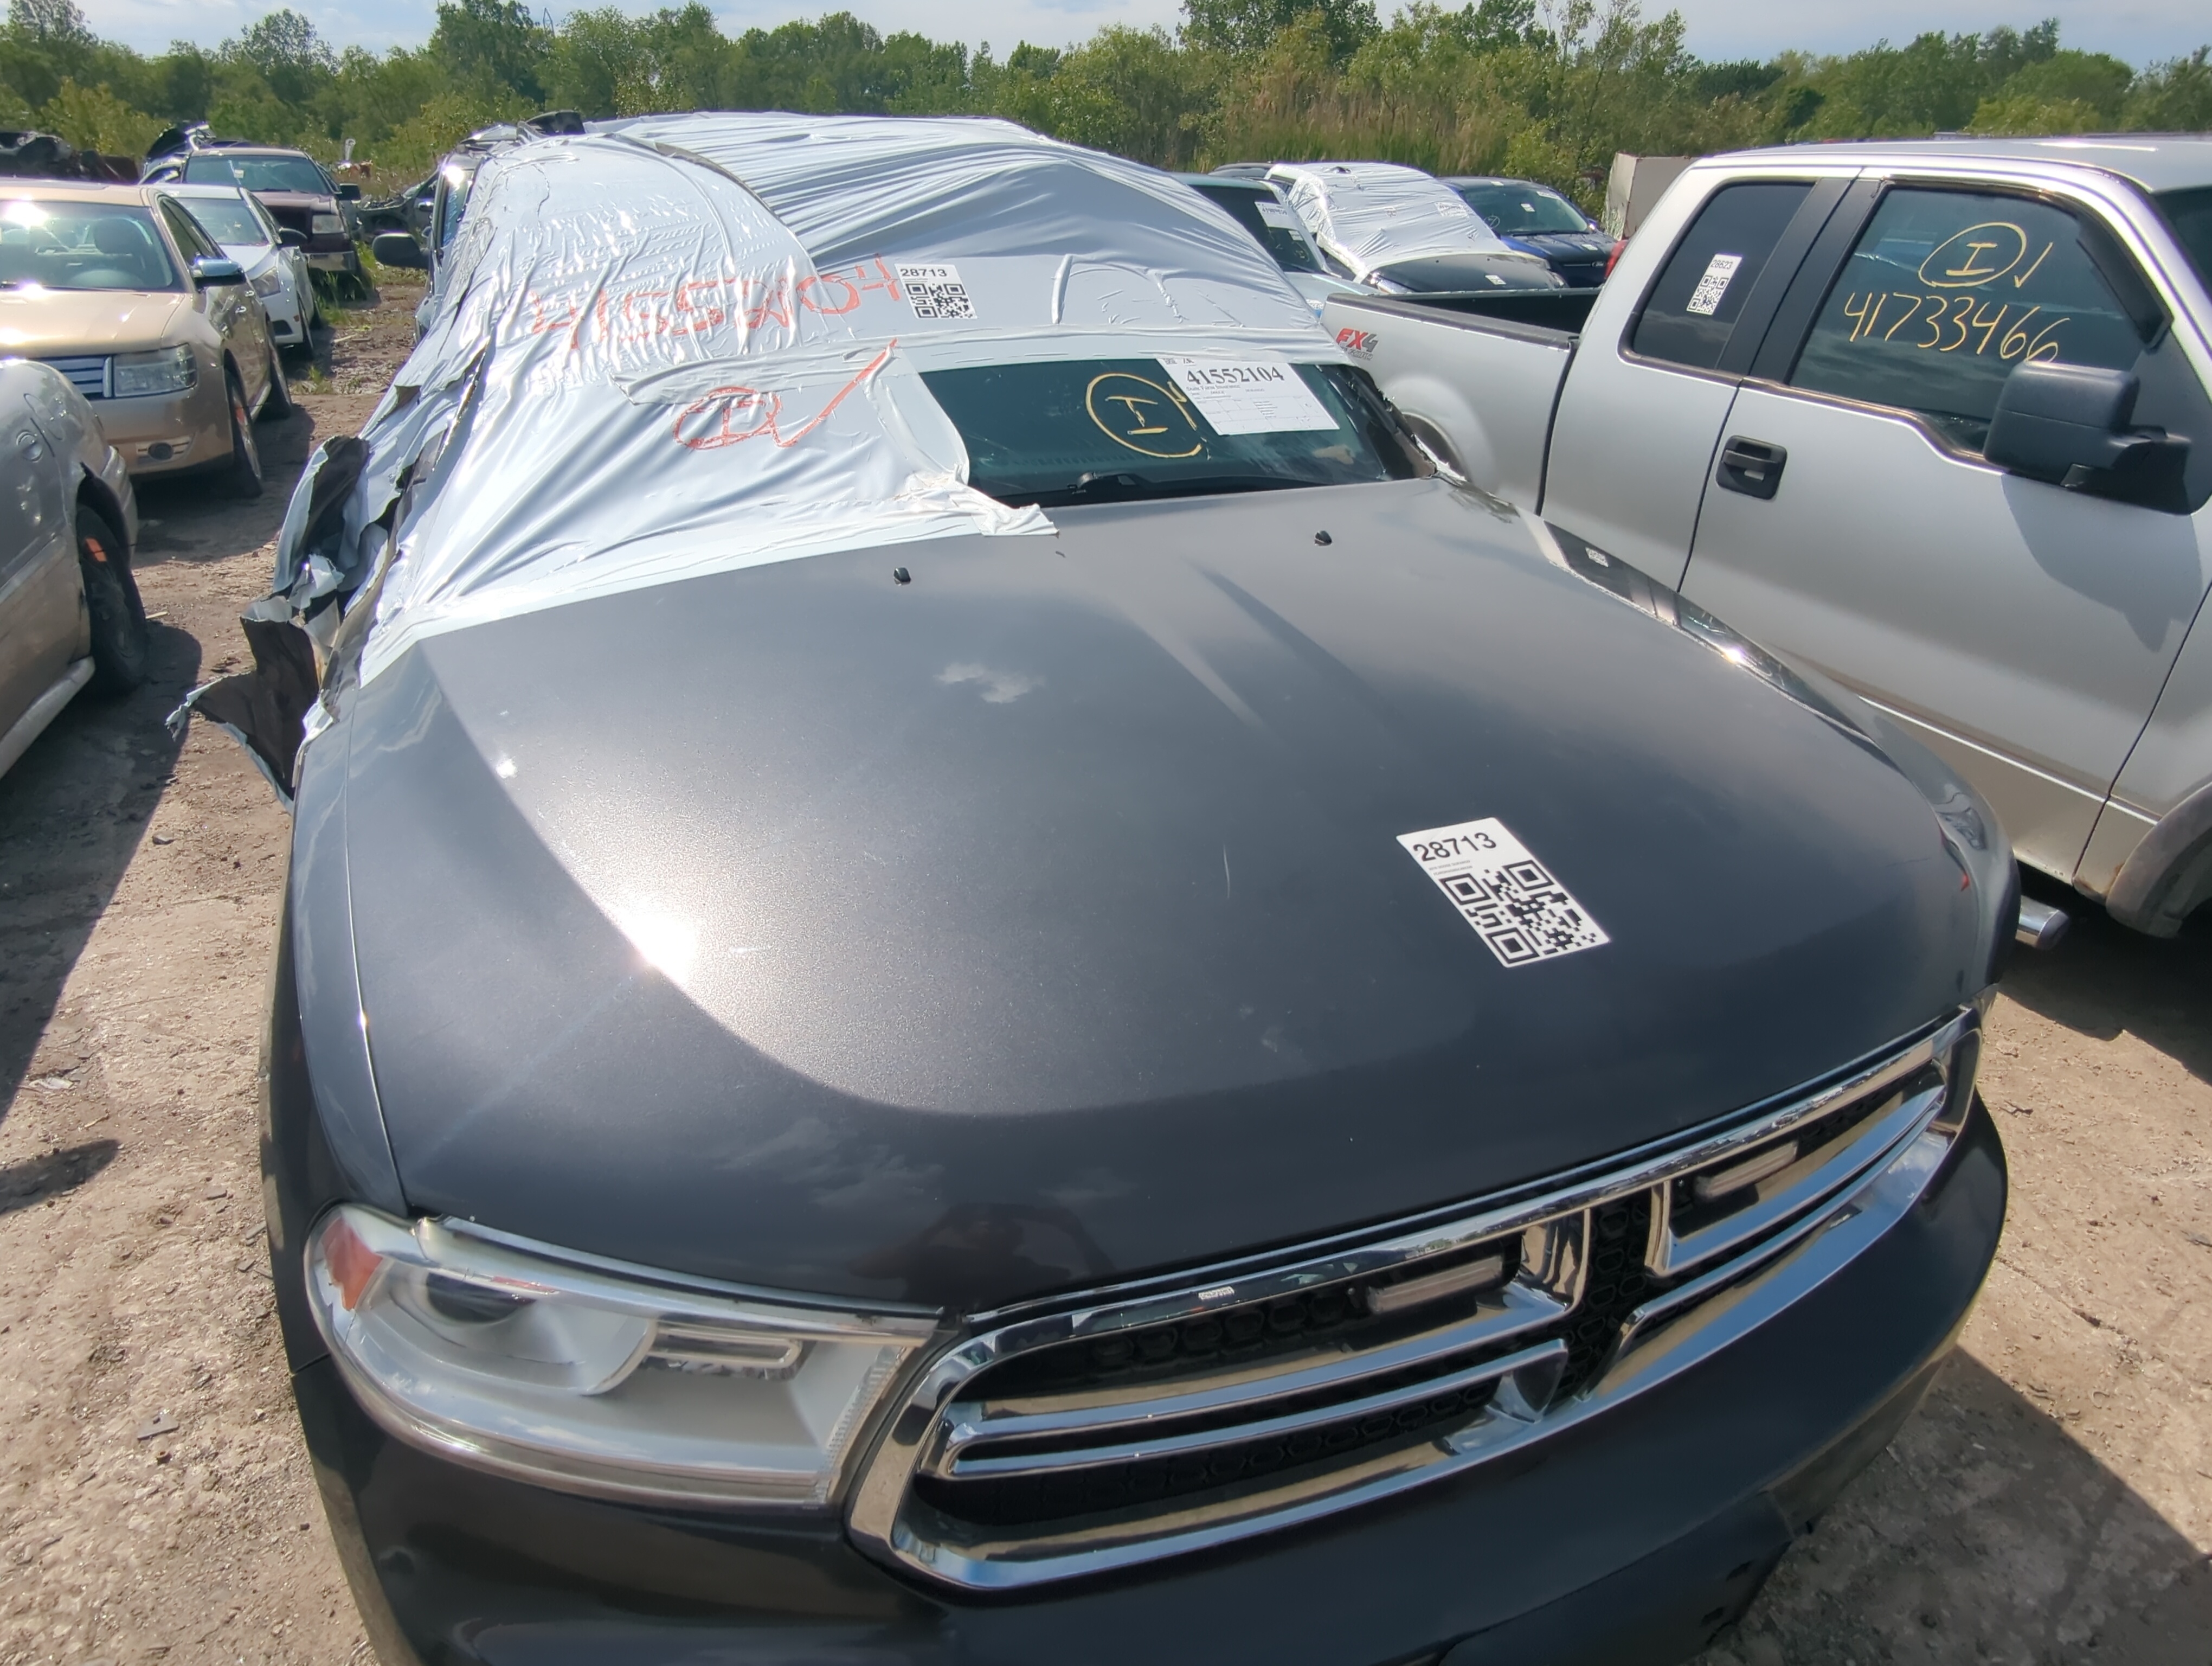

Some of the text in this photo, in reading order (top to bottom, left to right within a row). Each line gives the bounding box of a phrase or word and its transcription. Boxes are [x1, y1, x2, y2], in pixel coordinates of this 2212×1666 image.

[900, 268, 948, 277] 28713
[1335, 328, 1379, 353] FX4
[1844, 291, 2071, 363] 41733466
[1187, 366, 1285, 385] 41552104
[1105, 395, 1169, 435] I
[1413, 832, 1497, 862] 28713
